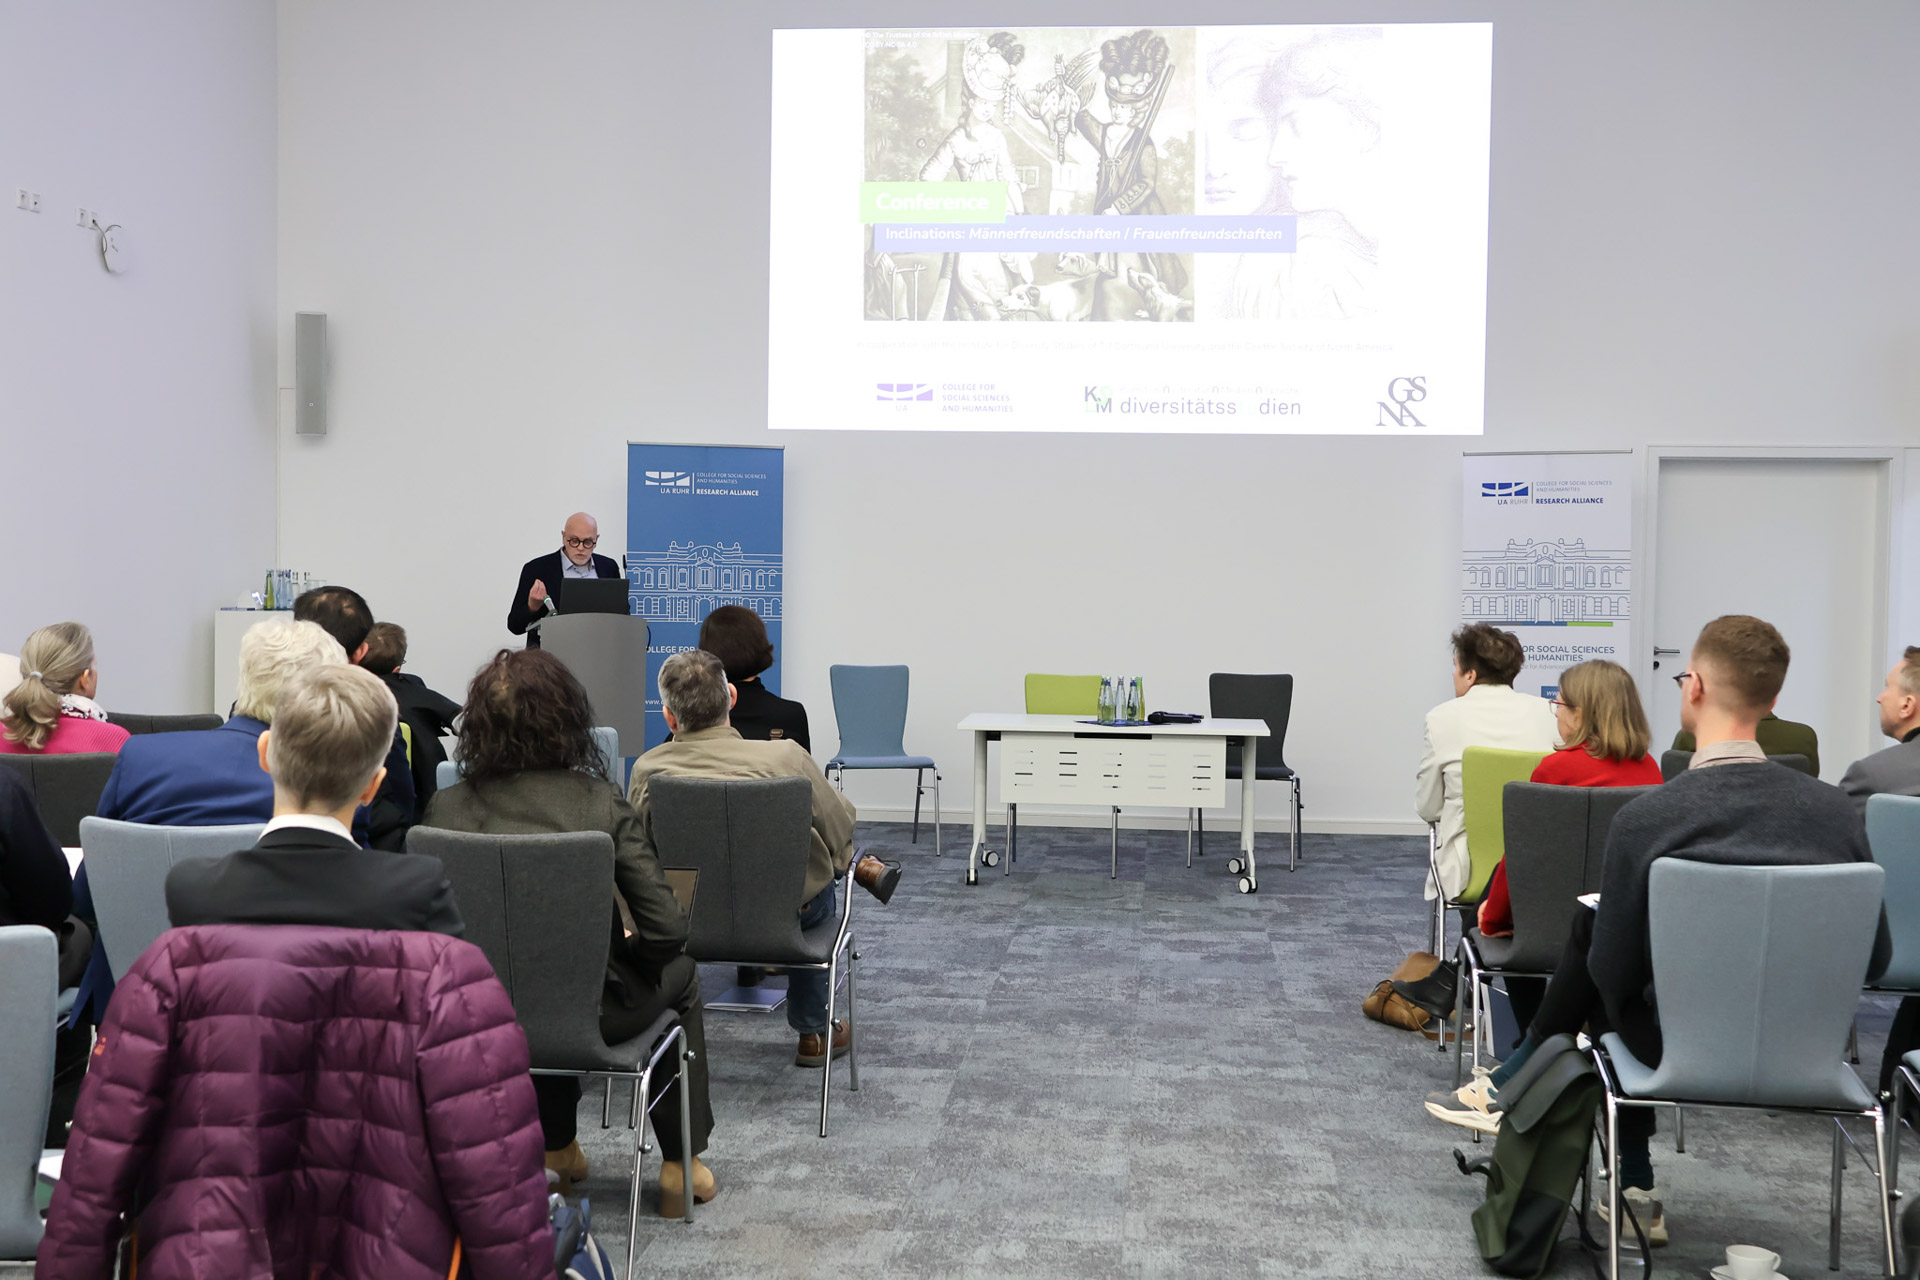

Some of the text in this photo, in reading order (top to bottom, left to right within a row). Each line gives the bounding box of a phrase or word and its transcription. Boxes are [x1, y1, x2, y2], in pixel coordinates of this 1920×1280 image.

[876, 192, 990, 212] Conference
[885, 226, 1283, 242] Inclinations: Männerfreundschaften / Frauenfreundschaften
[942, 383, 996, 391] COLLEGE FOR
[942, 394, 1011, 402] SOCIAL SCIENCES
[895, 404, 908, 412] UA
[942, 405, 1014, 413] AND HUMANITIES
[696, 488, 760, 497] RESEARCH ALLIANCE
[1536, 645, 1570, 654] SOCIAL
[1571, 645, 1616, 655] SCIENCES
[1528, 653, 1584, 662] HUMANITIES
